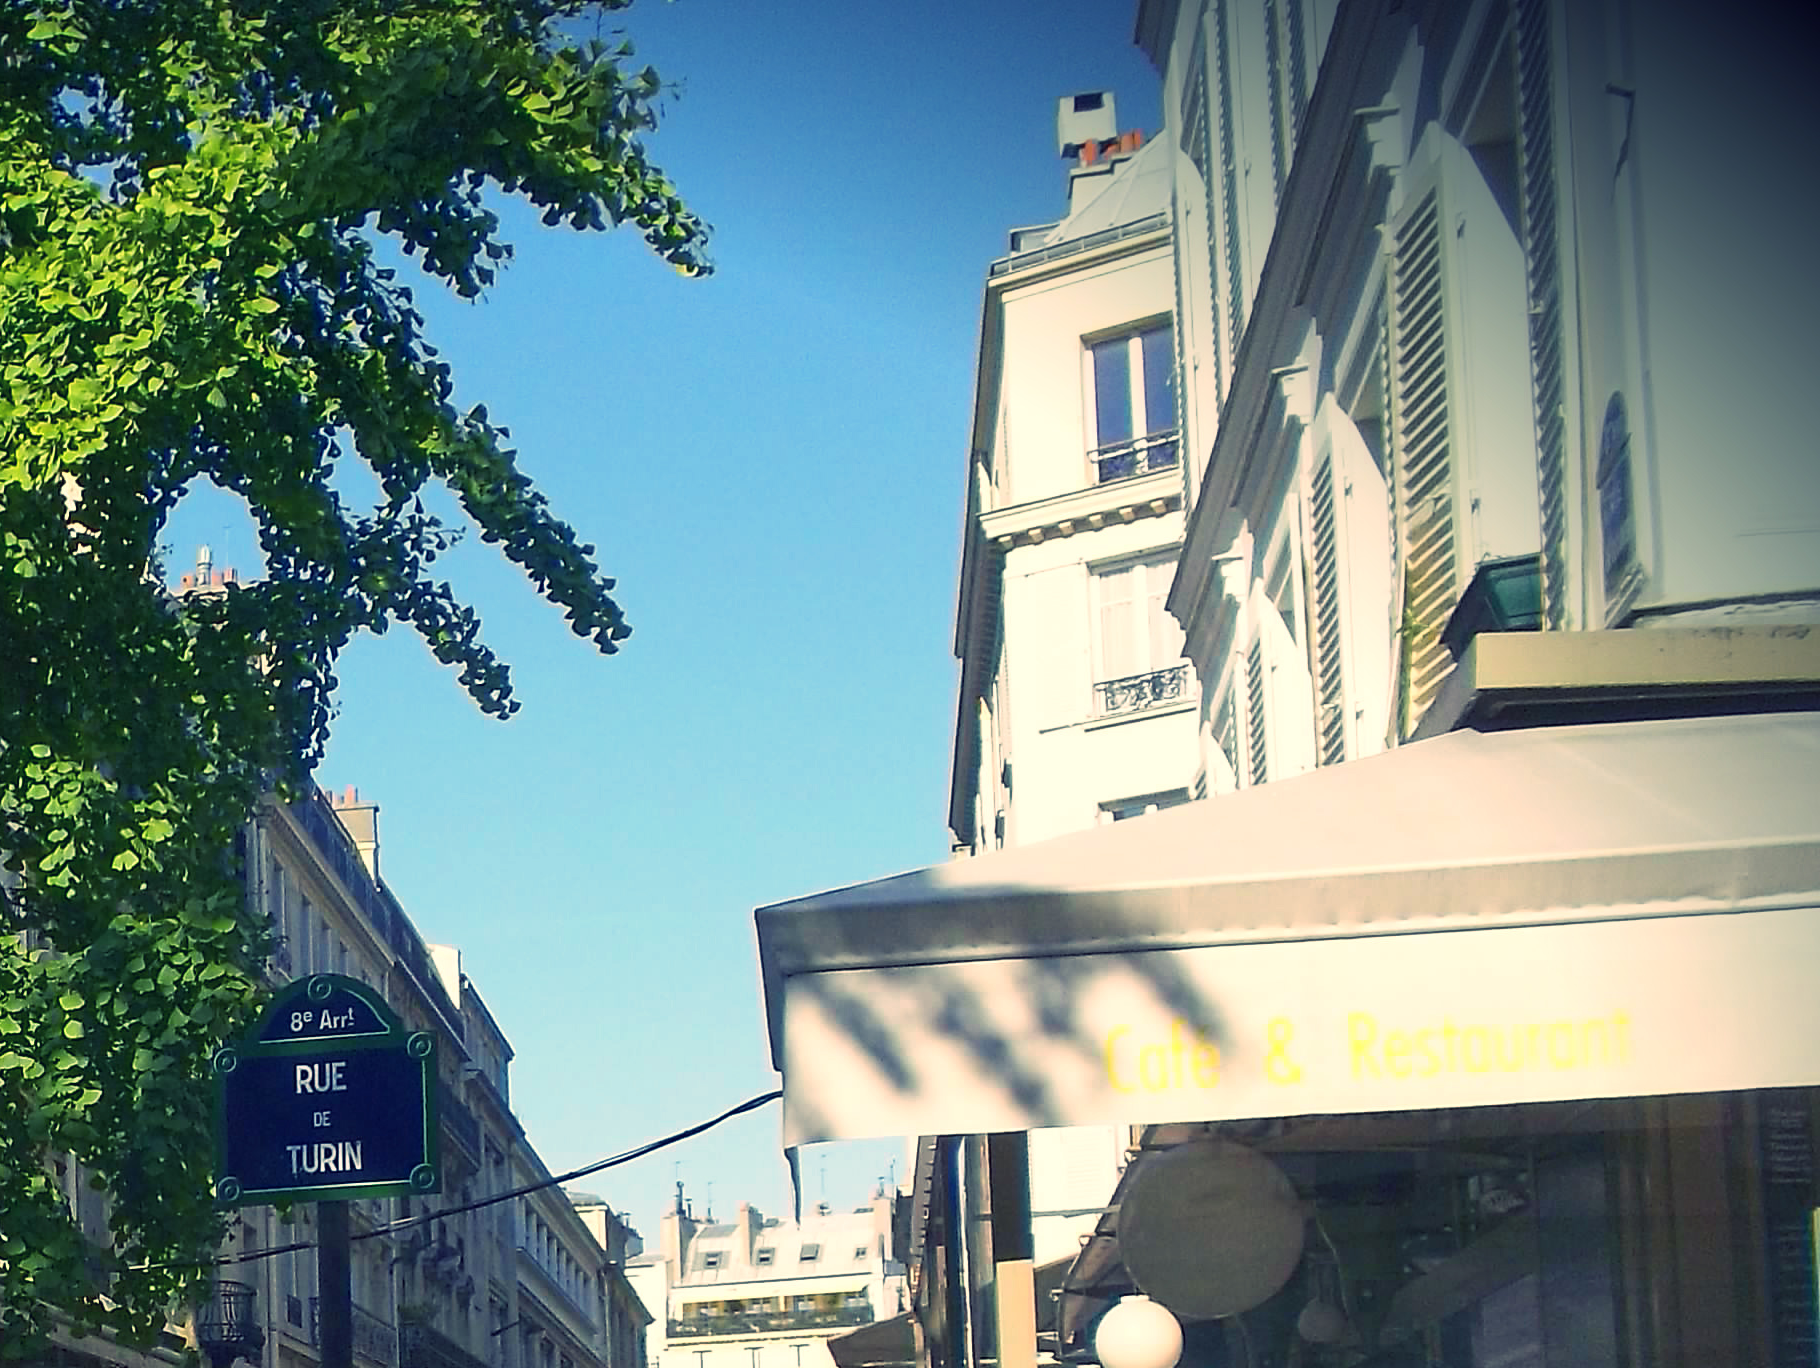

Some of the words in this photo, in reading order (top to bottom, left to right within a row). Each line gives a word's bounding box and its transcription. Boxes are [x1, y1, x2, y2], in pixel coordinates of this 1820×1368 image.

[1347, 1009, 1633, 1081] Restaurant
[295, 1061, 348, 1094] RUE
[313, 1111, 331, 1128] DE
[286, 1140, 363, 1175] TURIN
